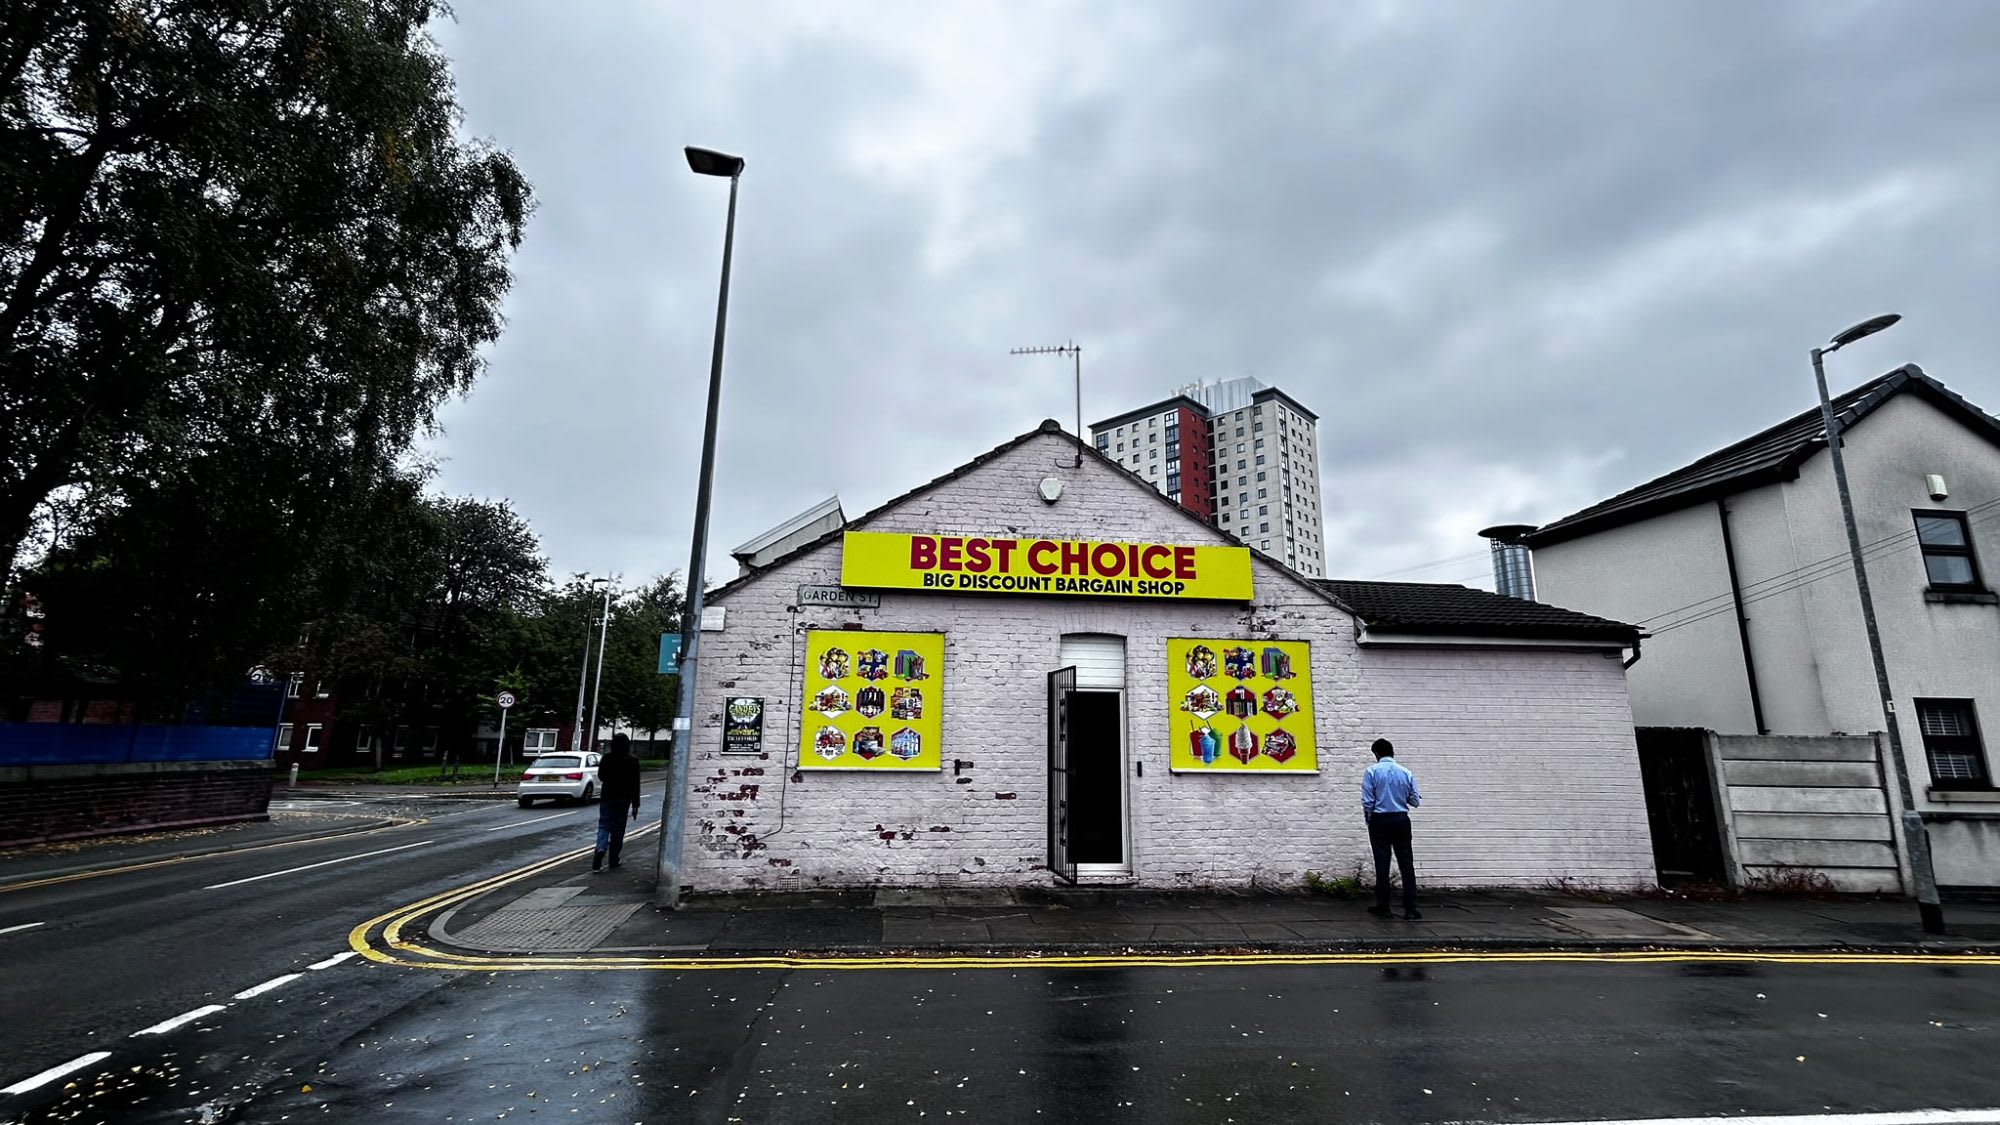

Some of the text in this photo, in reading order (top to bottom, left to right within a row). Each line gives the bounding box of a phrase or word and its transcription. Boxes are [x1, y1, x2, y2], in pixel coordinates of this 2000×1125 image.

[910, 535, 1197, 579] BEST CHOICE
[923, 572, 1185, 595] BIG DISCOUNT BARGAIN SHOP
[803, 590, 877, 603] GARDEN ST.
[499, 696, 513, 705] 20
